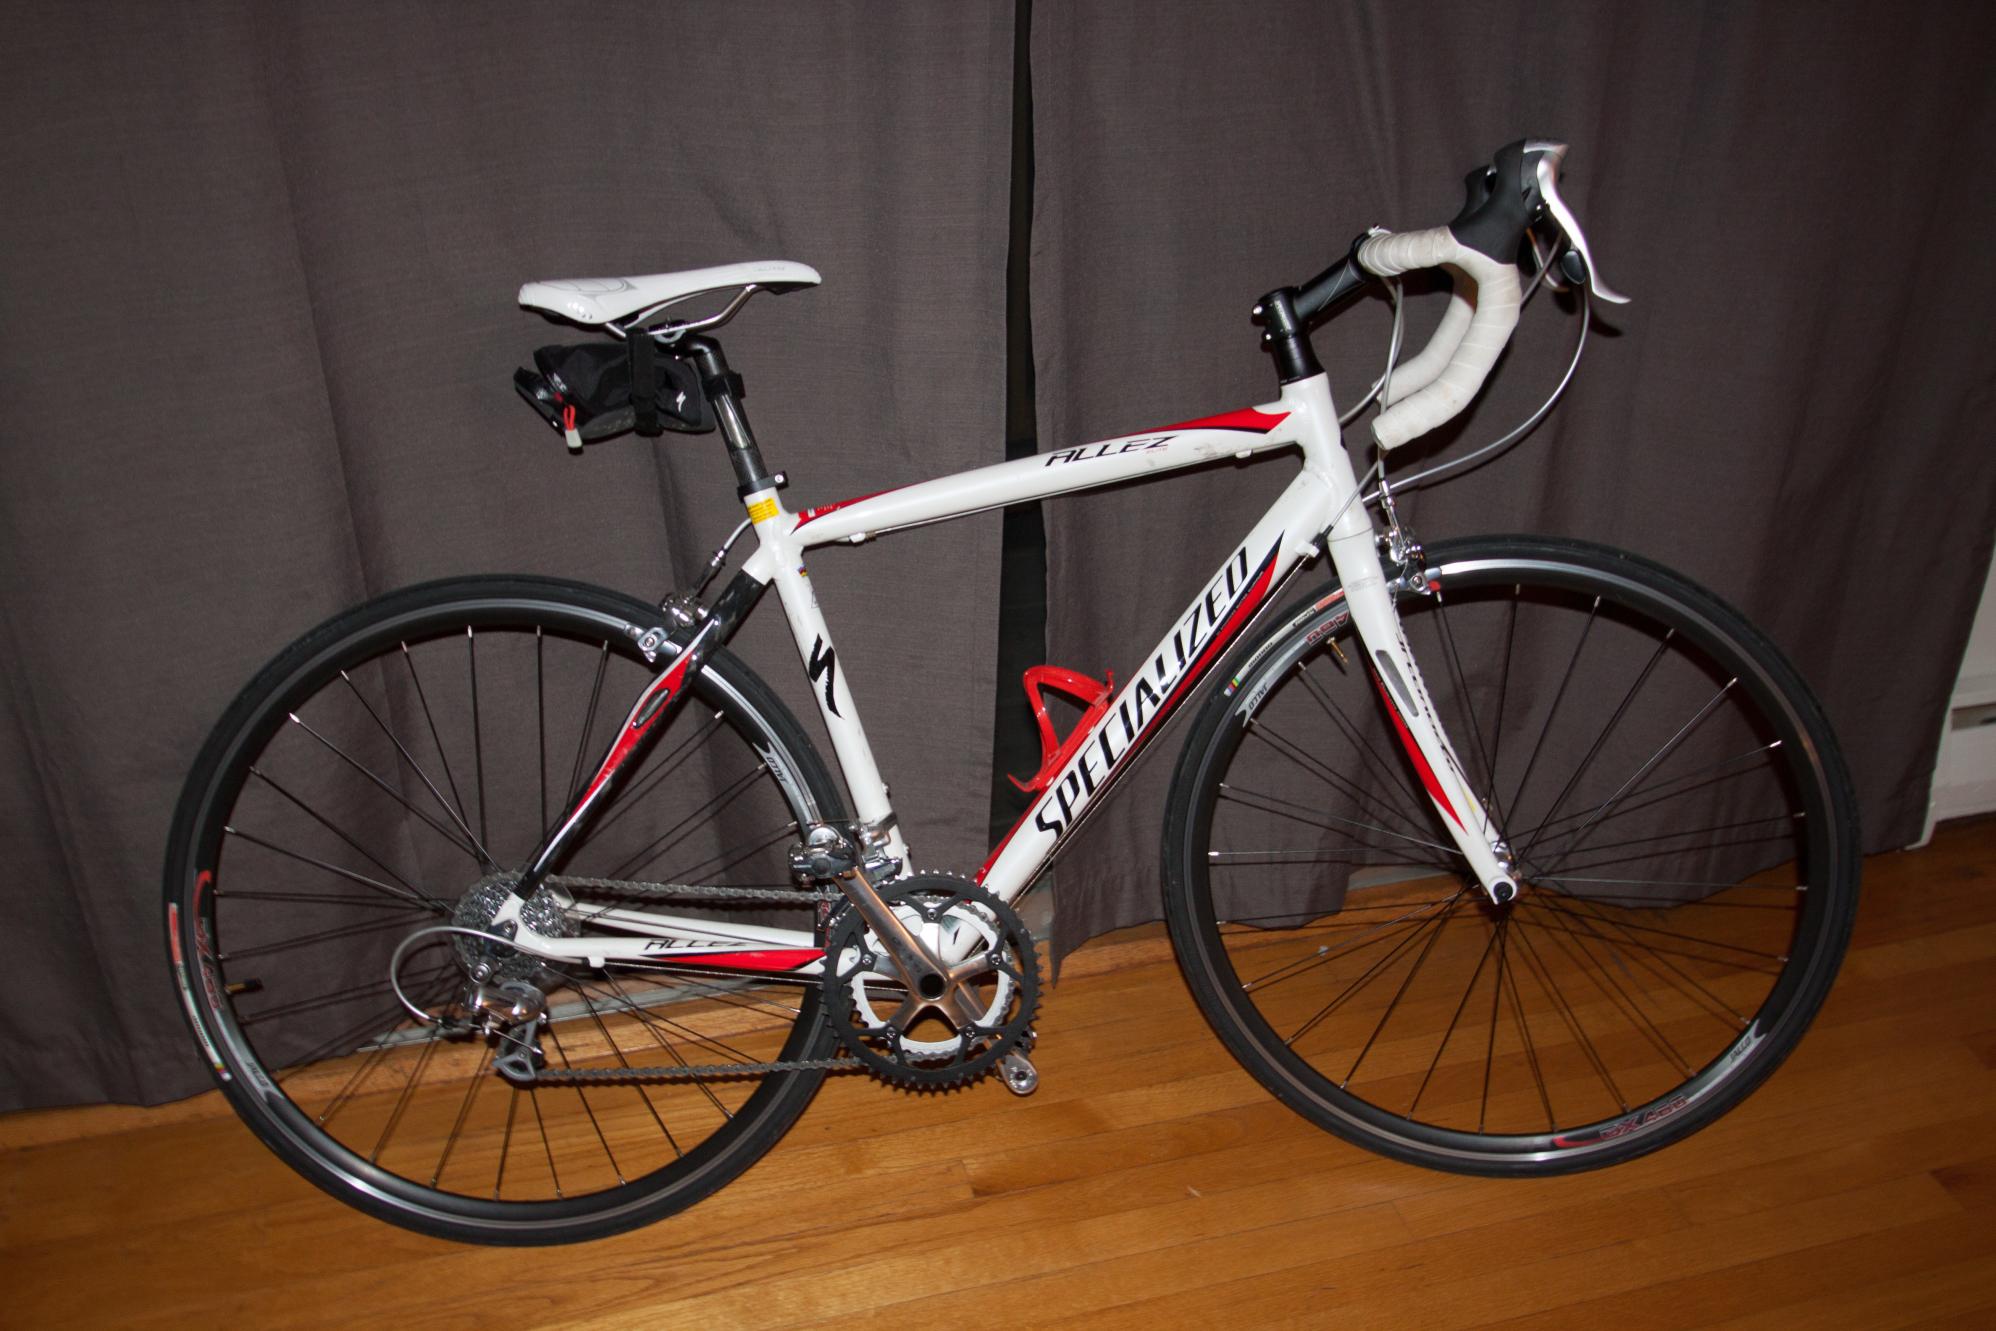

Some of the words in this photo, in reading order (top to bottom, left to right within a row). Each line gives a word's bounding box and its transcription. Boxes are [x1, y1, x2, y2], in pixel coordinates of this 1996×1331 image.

[1044, 435, 1178, 467] ALLEZ
[1035, 546, 1249, 840] SPECIALIZED
[644, 938, 747, 950] ALLEZ
